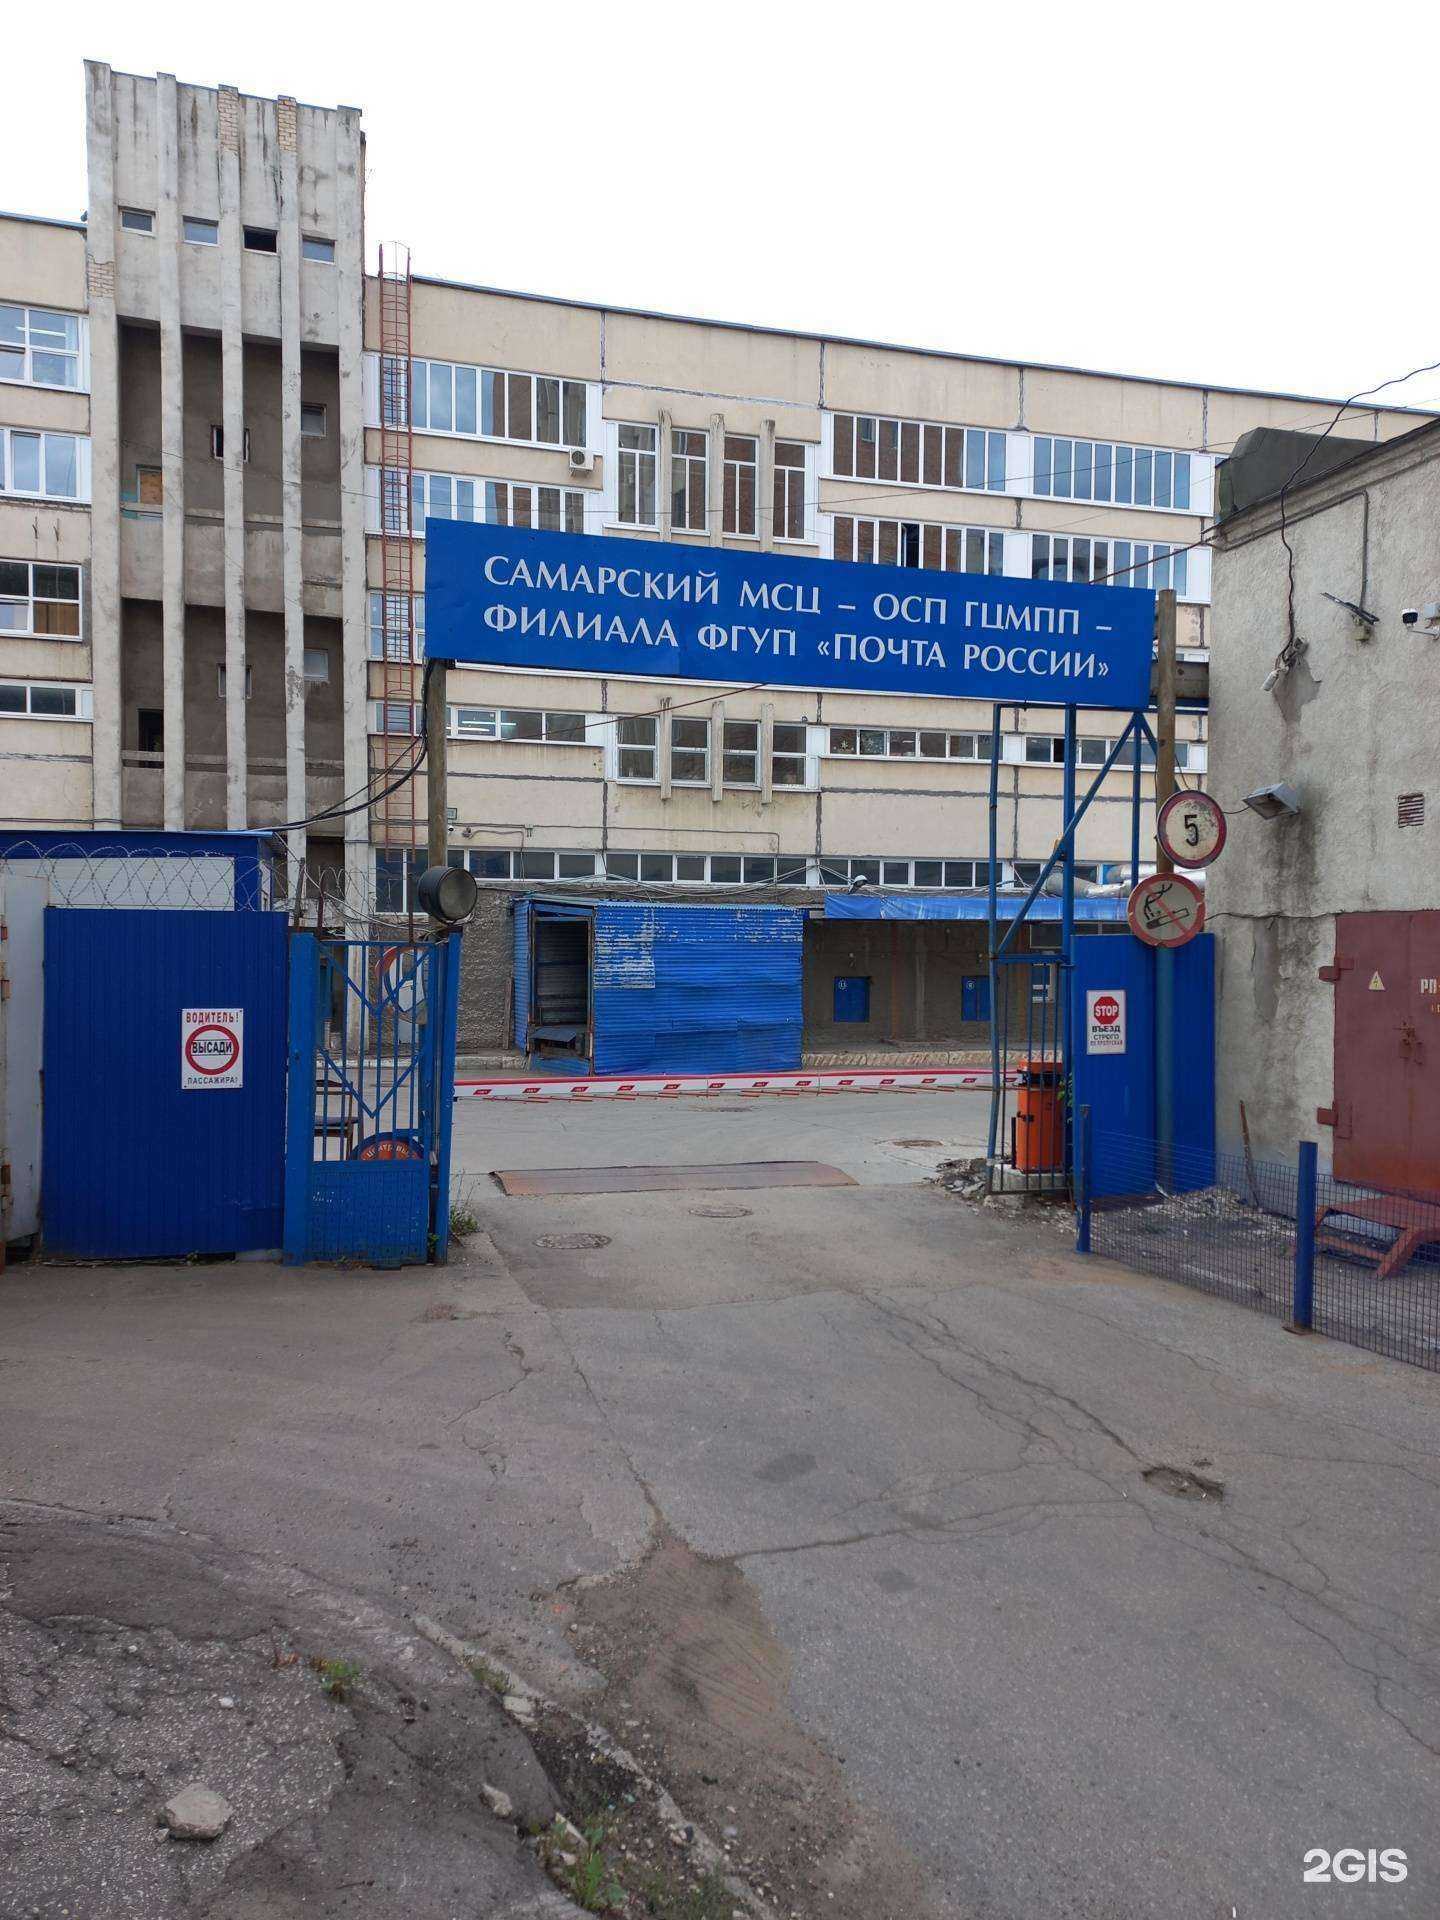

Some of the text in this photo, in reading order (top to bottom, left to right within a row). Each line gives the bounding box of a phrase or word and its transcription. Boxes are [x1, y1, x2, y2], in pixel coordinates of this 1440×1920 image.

[484, 555, 718, 605] САМАРСКИЙ
[740, 581, 821, 616] МСЦ
[873, 593, 947, 625] ОСП
[965, 601, 1081, 635] ГЦМПП
[484, 603, 1109, 678] ФИЛИАЛА ФГУП «ПОЧТА РОССИИ»
[1184, 814, 1199, 847] 5
[1095, 1005, 1118, 1016] STOP
[186, 1012, 239, 1024] ВОДИТЕЛЬ!
[1092, 1025, 1121, 1033] ВЪЕЗД
[192, 1041, 232, 1055] ВЫСАДИ
[187, 1076, 238, 1085] ПАССАЖИРА!
